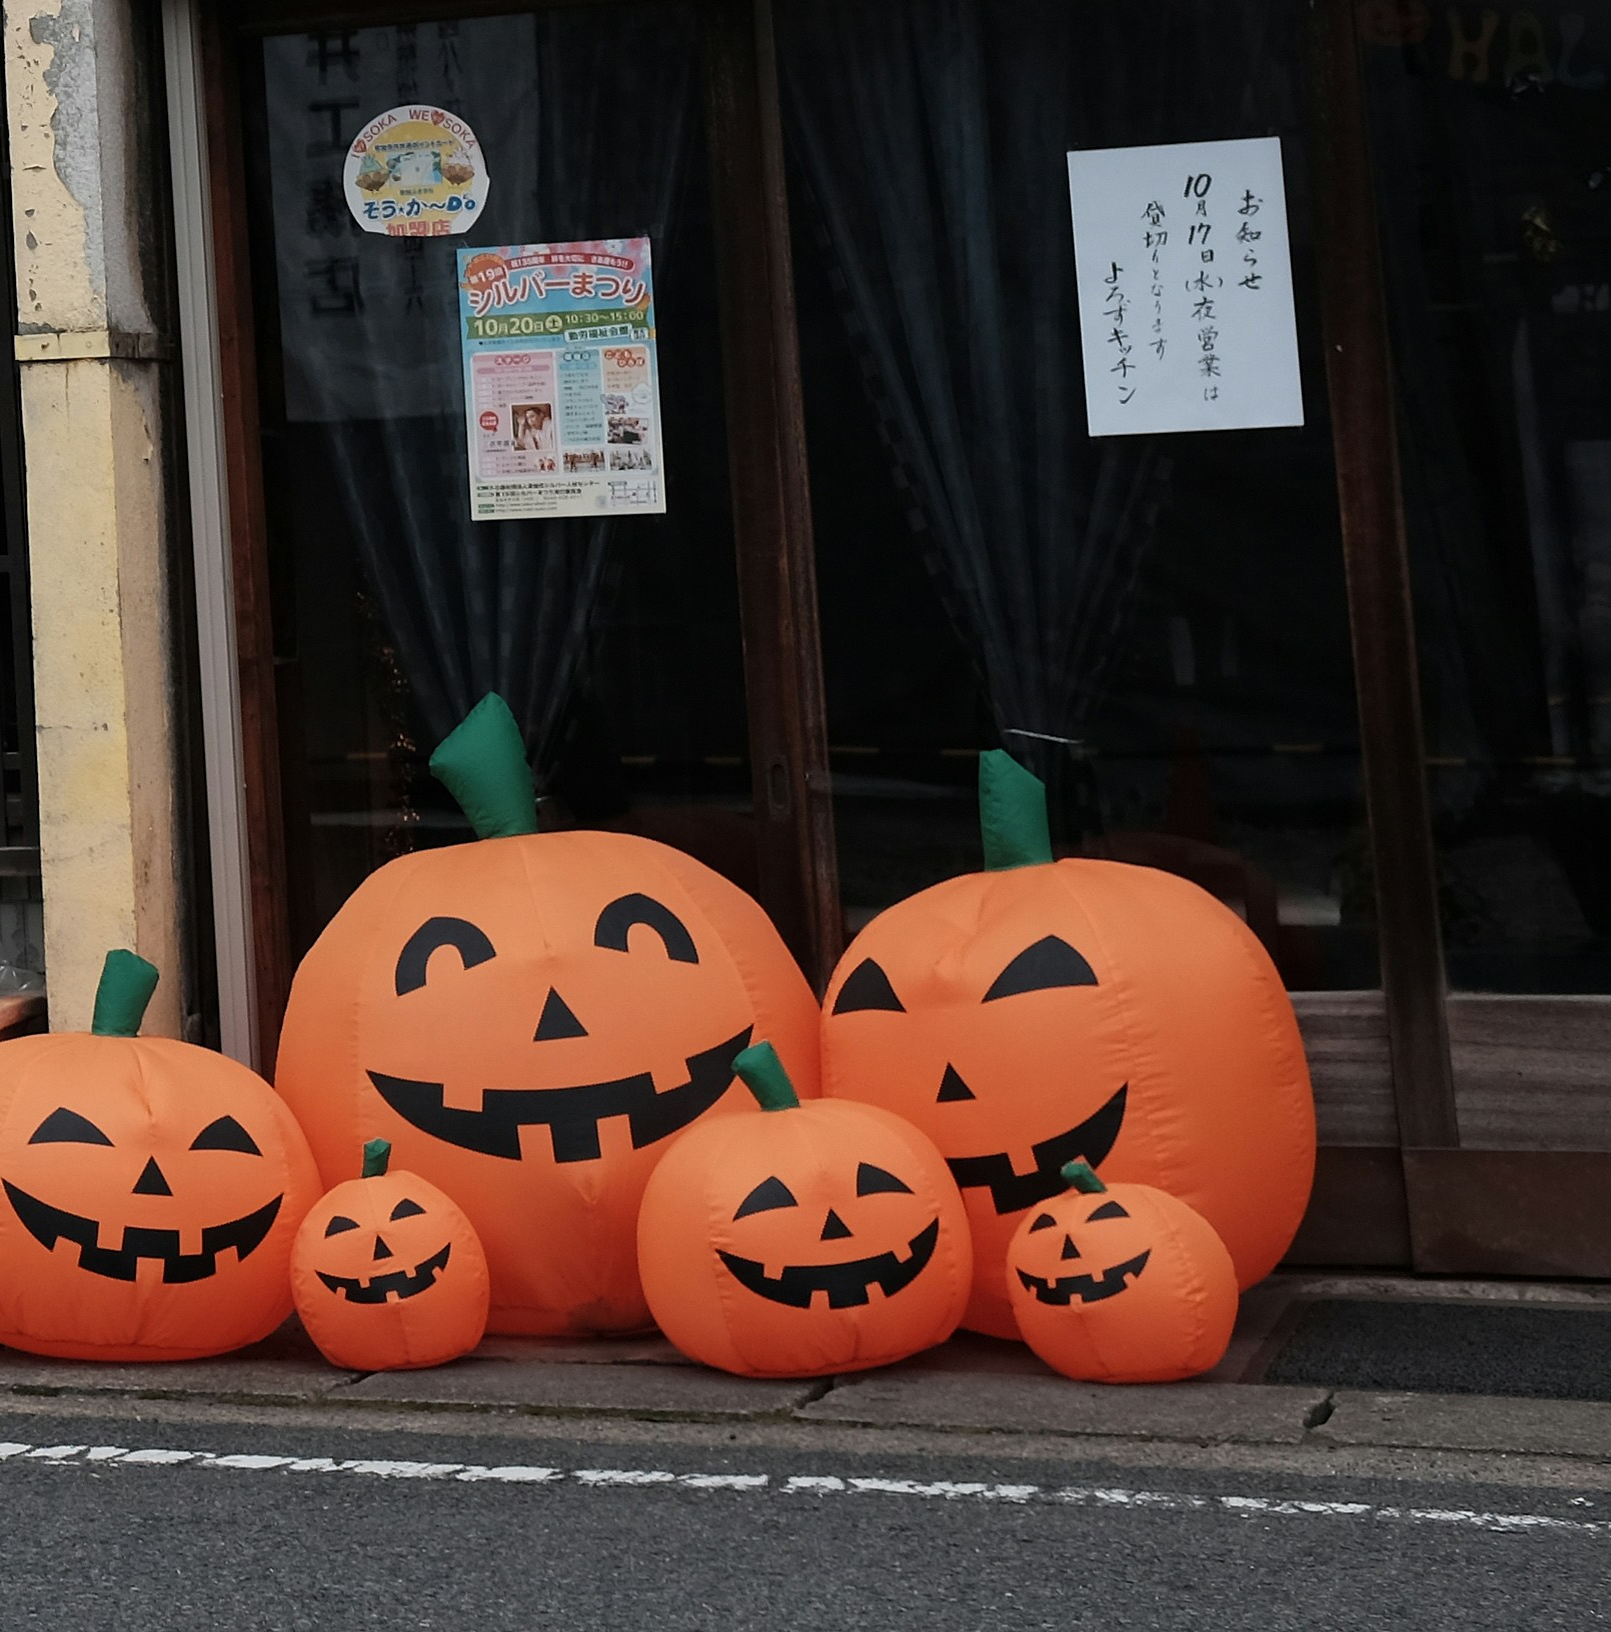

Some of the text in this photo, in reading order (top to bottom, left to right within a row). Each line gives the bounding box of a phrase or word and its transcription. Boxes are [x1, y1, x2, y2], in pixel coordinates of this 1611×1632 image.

[363, 114, 397, 143] SOKA
[409, 109, 477, 149] WE SOKA
[1237, 189, 1264, 291] お知らせ
[468, 271, 646, 317] シルバーまつり
[1102, 261, 1137, 405] よろずキッチン
